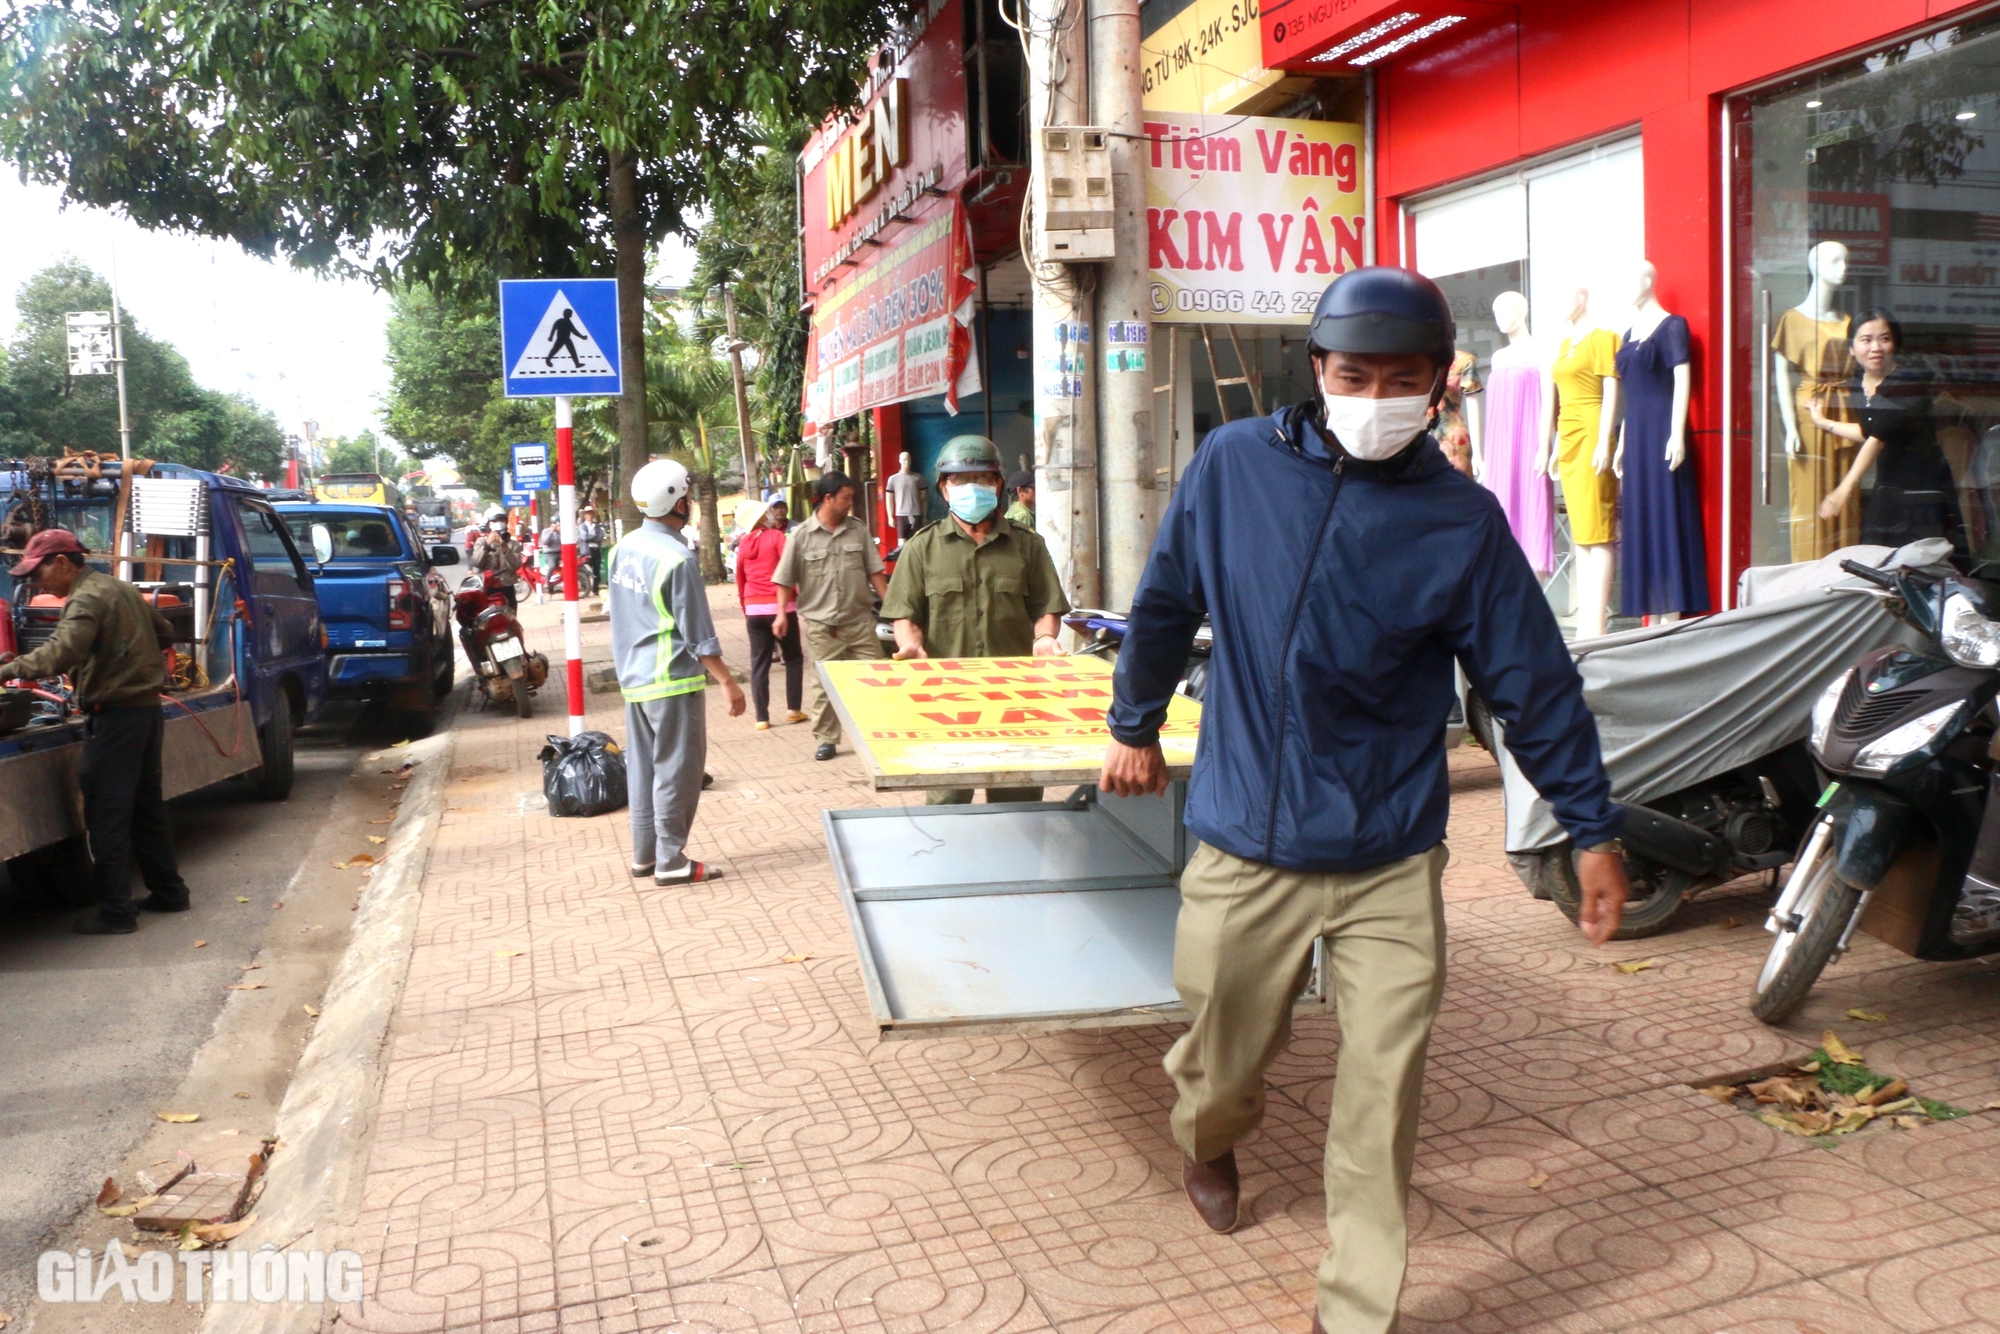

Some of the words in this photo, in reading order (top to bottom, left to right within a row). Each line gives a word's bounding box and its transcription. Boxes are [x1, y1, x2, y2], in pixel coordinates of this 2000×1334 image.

[1173, 38, 1193, 74] 18K
[1200, 16, 1223, 56] 24K
[1231, 0, 1258, 33] SJC
[1288, 17, 1305, 37] 135
[826, 77, 905, 231] MEN
[1143, 121, 1242, 180] Tiệm
[1255, 128, 1357, 194] Vàng
[1147, 207, 1245, 272] KIM
[1257, 196, 1365, 274] VÂN
[1176, 288, 1244, 313] 0966
[1251, 290, 1286, 313] 44
[857, 660, 1074, 672] TIỆM
[908, 689, 1113, 703] KIM
[946, 729, 1050, 739] 0966
